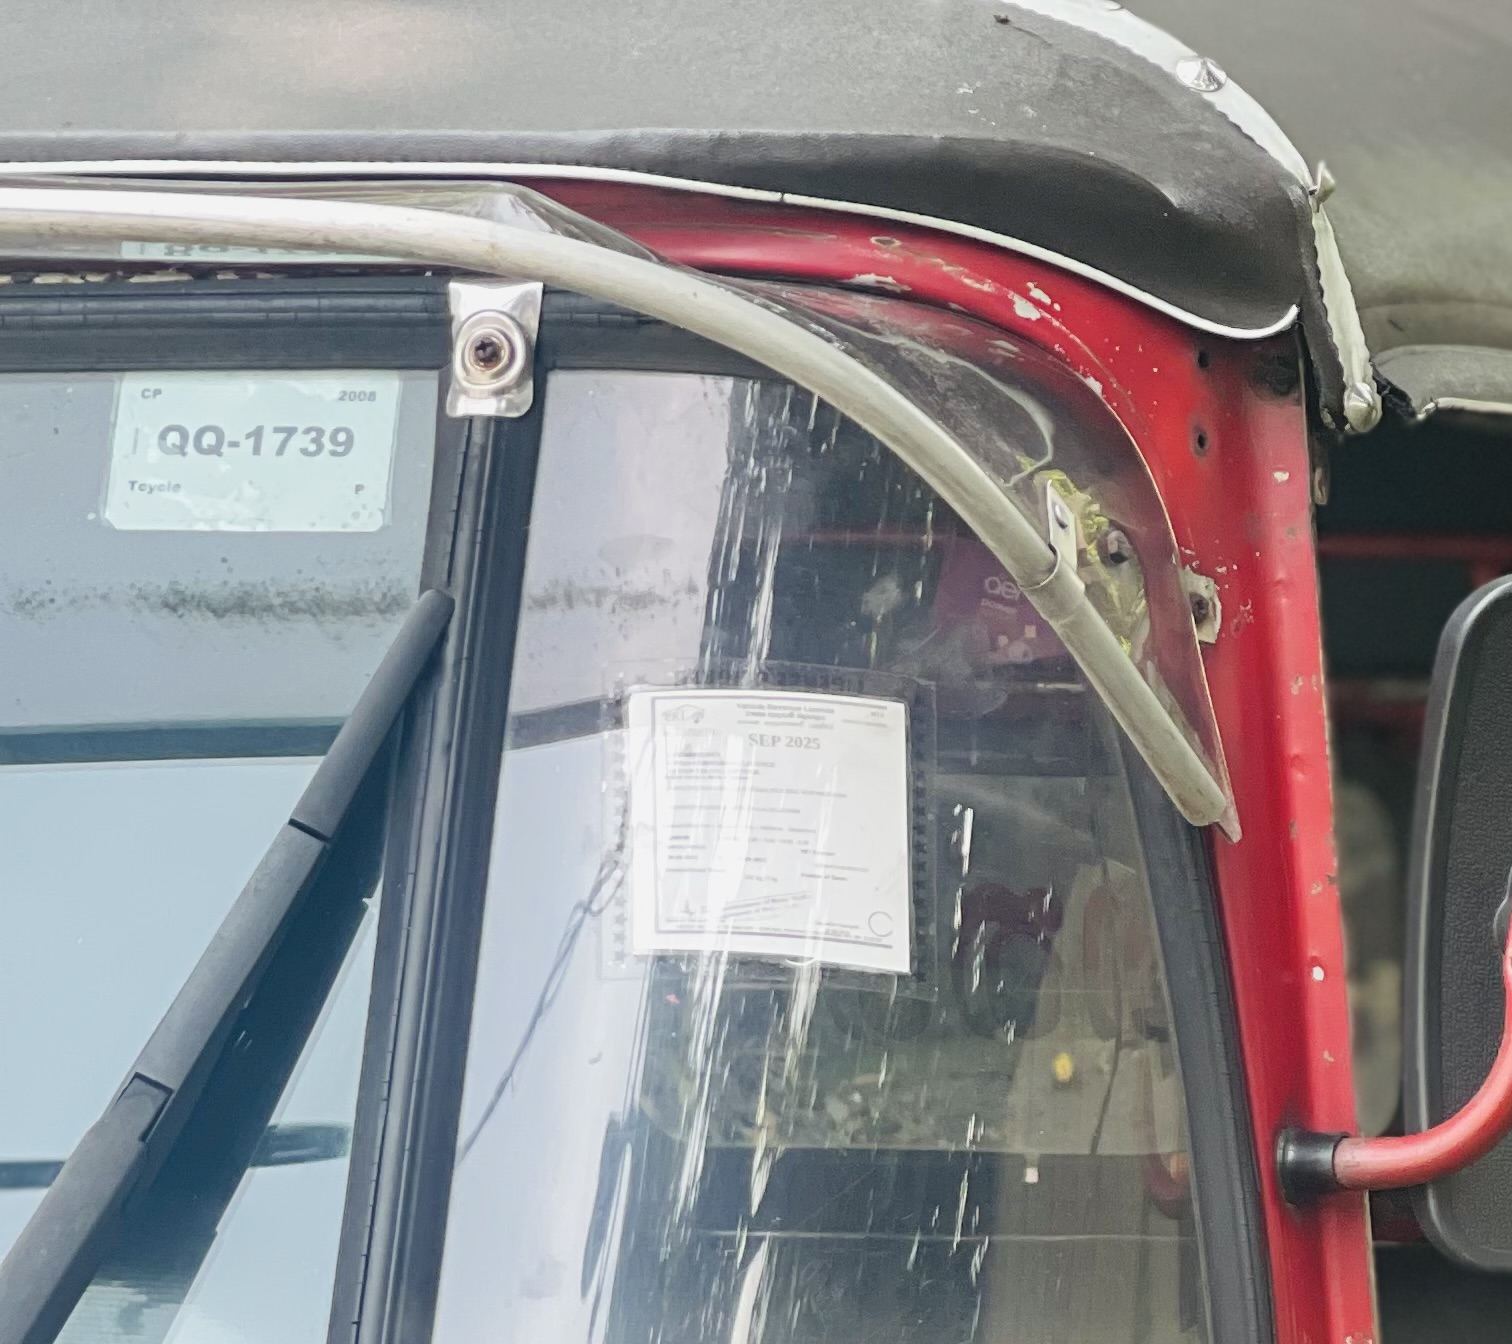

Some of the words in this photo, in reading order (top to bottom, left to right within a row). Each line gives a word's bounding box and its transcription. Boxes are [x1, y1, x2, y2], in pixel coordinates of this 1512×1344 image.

[141, 388, 162, 399] CP
[157, 424, 355, 458] QQ-1739
[355, 484, 364, 495] P
[749, 733, 781, 747] SEP
[785, 735, 821, 750] 2025
